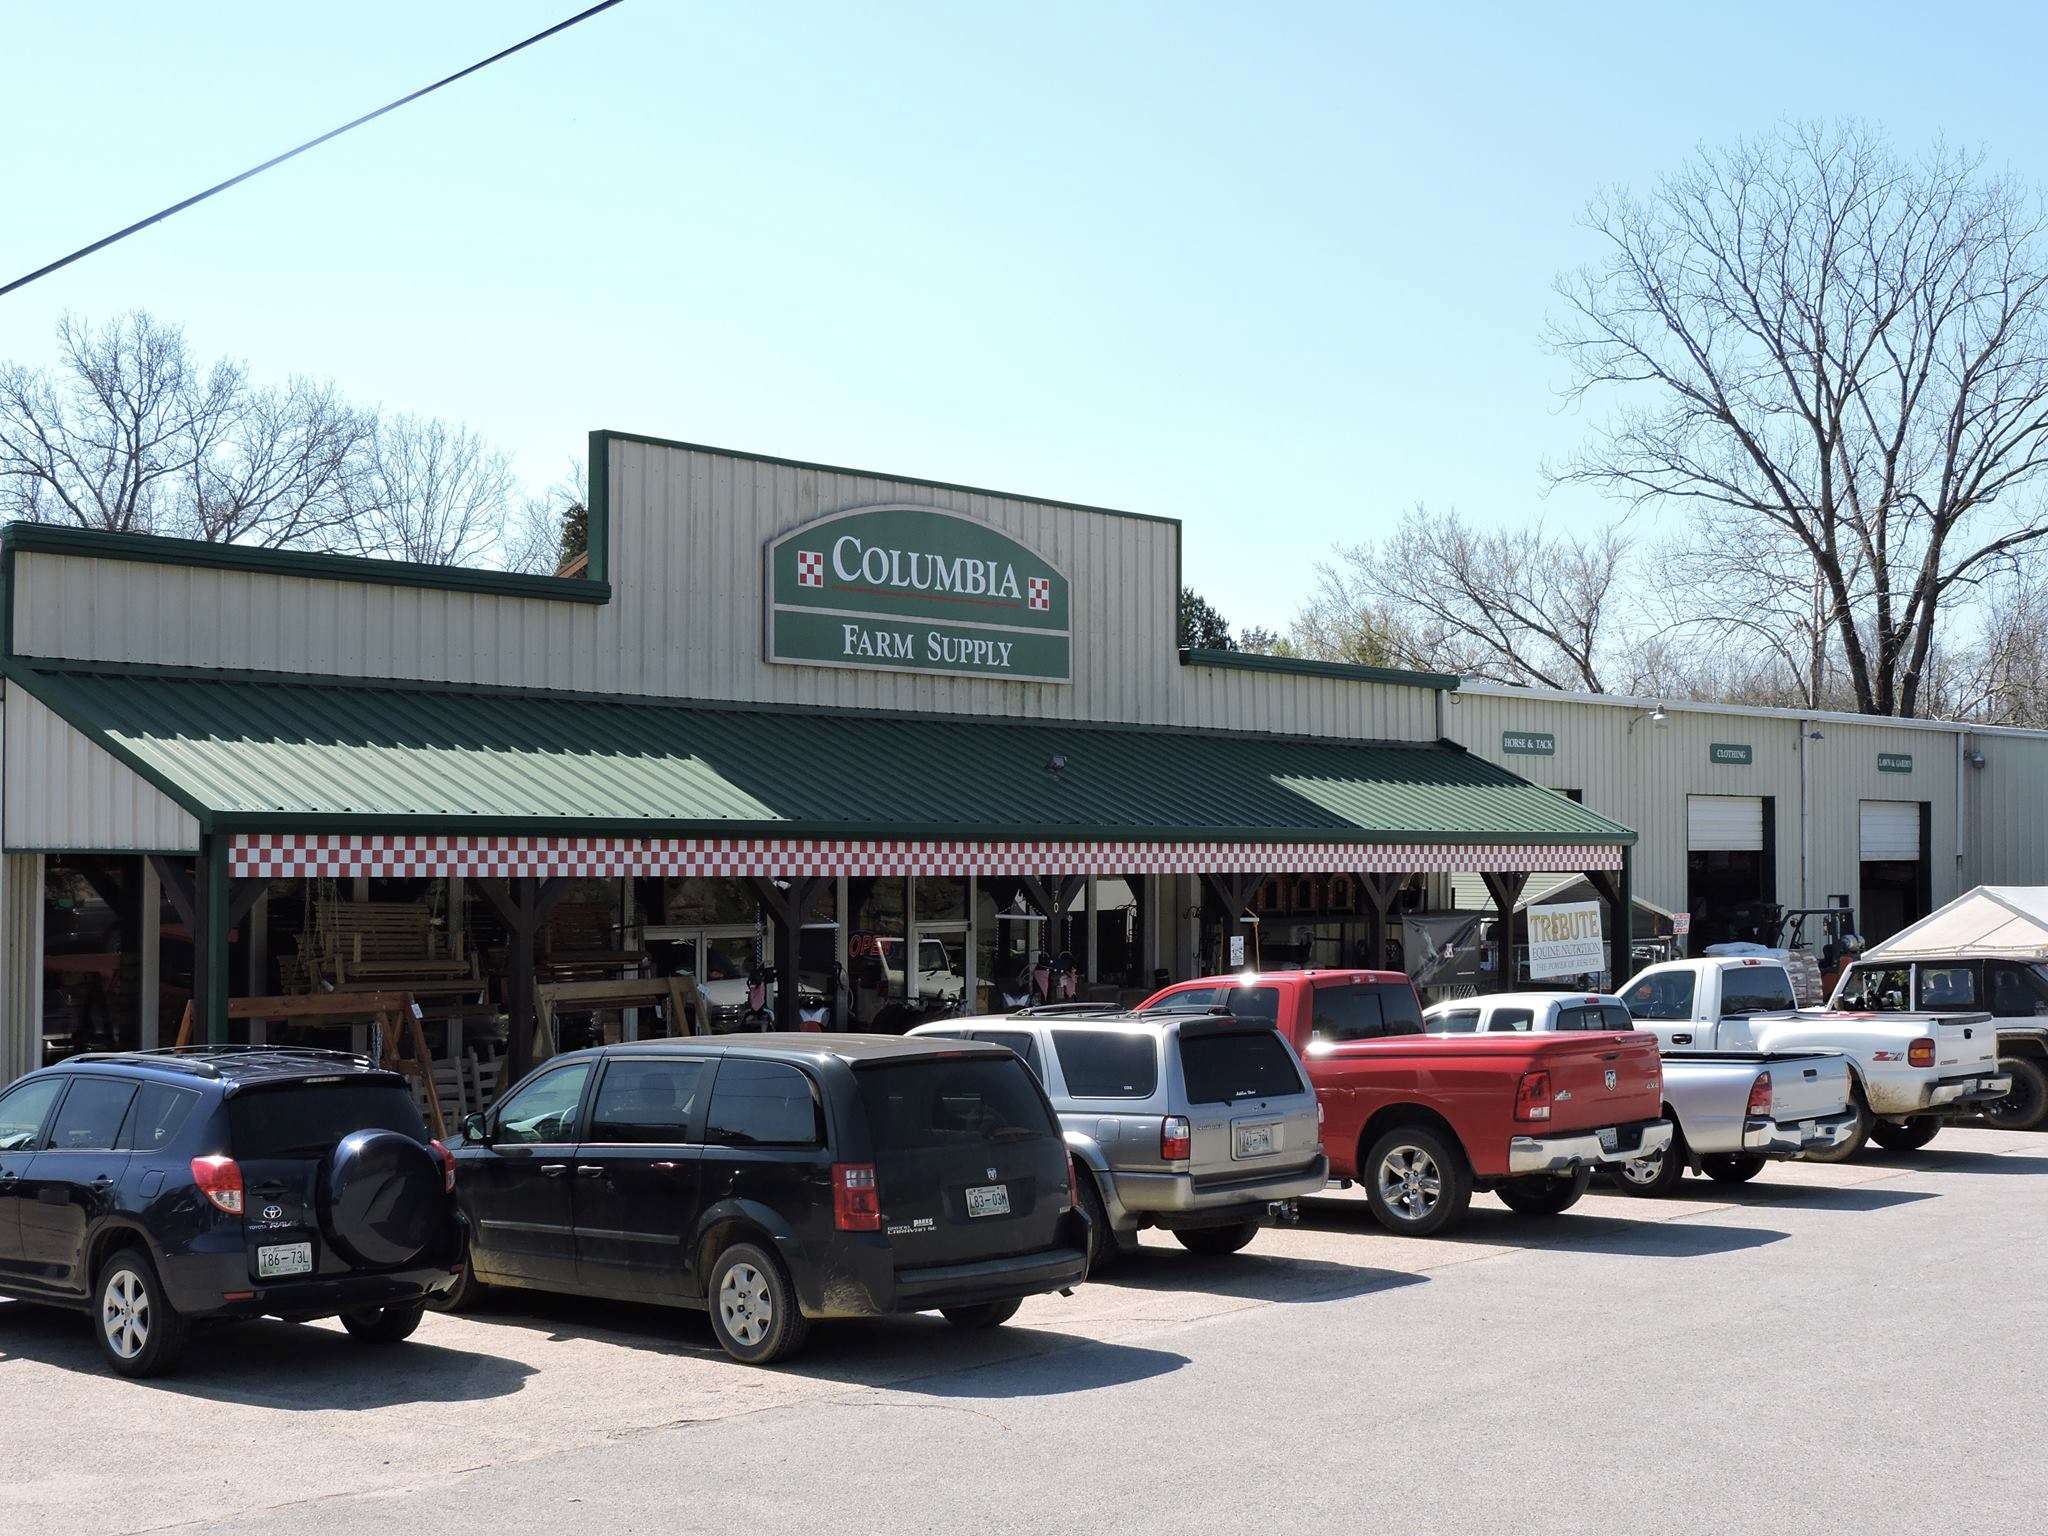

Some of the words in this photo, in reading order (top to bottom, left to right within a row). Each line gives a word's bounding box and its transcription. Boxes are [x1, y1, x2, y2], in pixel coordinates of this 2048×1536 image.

[832, 535, 1022, 599] COLUMBIA
[842, 624, 914, 660] FARM
[927, 631, 1014, 667] SUPPLY
[1504, 737, 1526, 748] HORSE
[1527, 739, 1534, 749] &
[1536, 739, 1553, 749] TACK
[1716, 749, 1746, 759] CLOTHING
[1528, 910, 1600, 943] TRIBUTE
[1532, 945, 1560, 960] EQUINE
[1561, 942, 1600, 956] NUTRITION
[1872, 1051, 1905, 1061] Z71
[262, 1250, 309, 1268] T86-73L
